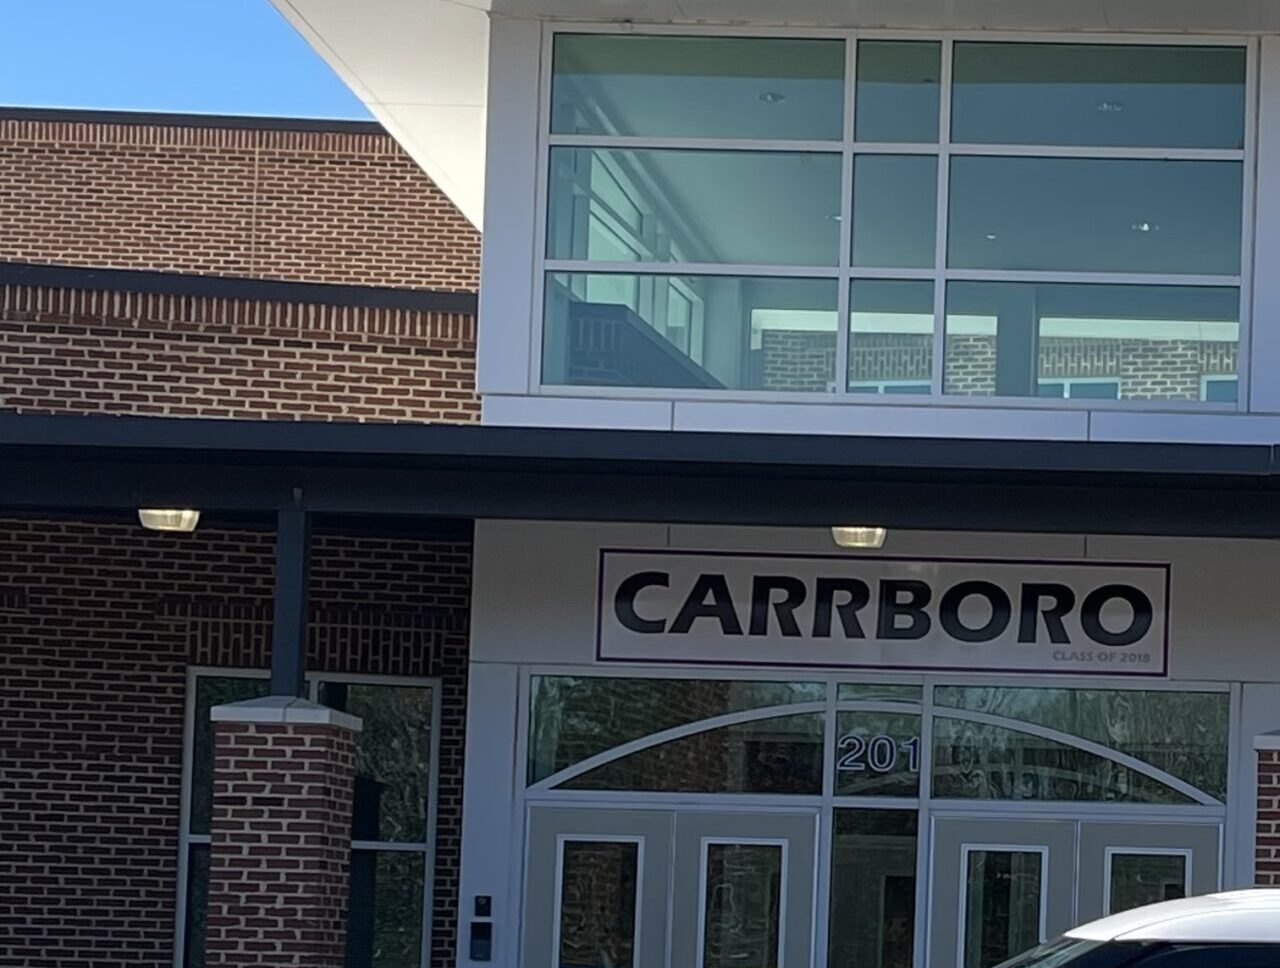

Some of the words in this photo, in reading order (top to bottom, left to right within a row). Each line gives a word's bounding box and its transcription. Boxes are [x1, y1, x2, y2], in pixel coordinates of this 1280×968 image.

[613, 570, 1154, 647] CARRBORO
[1052, 650, 1094, 662] CLASS
[1097, 651, 1117, 662] OF
[1119, 652, 1151, 663] 2018
[837, 734, 920, 772] 201
